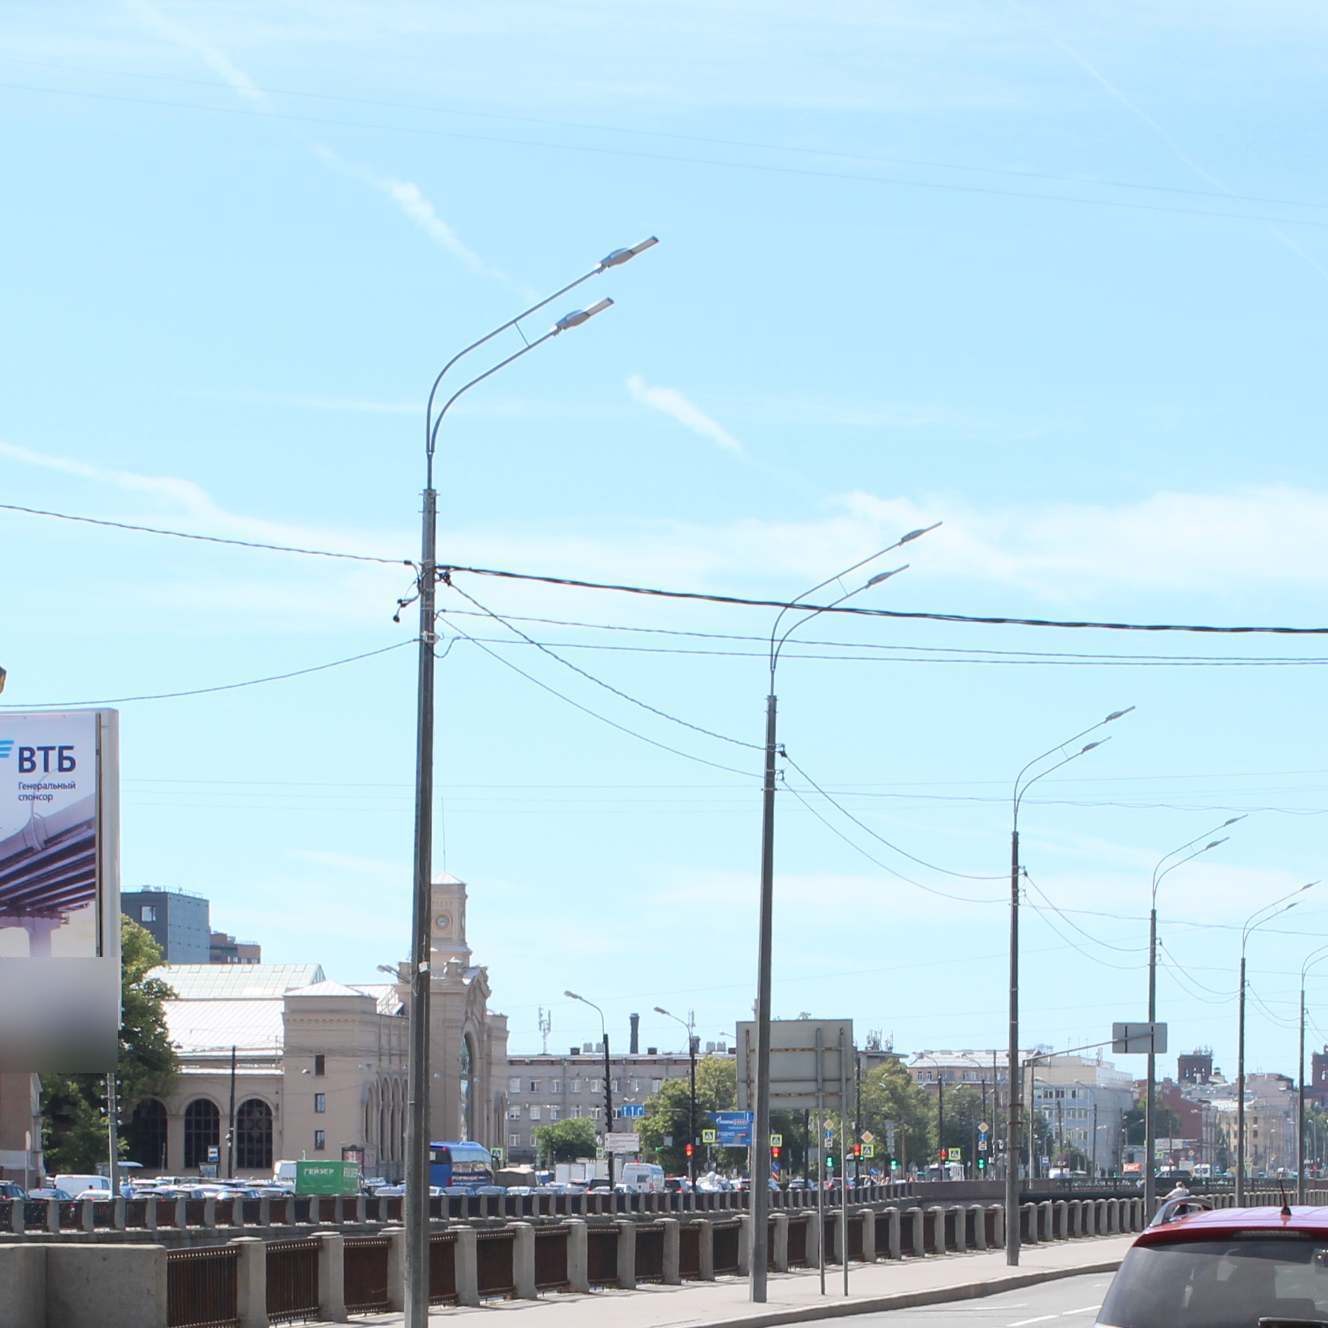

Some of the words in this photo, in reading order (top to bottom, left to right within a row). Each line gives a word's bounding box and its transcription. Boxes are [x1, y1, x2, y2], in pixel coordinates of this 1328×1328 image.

[18, 745, 76, 773] ВТБ
[18, 781, 76, 792] Генеральный
[18, 793, 53, 803] спонсор
